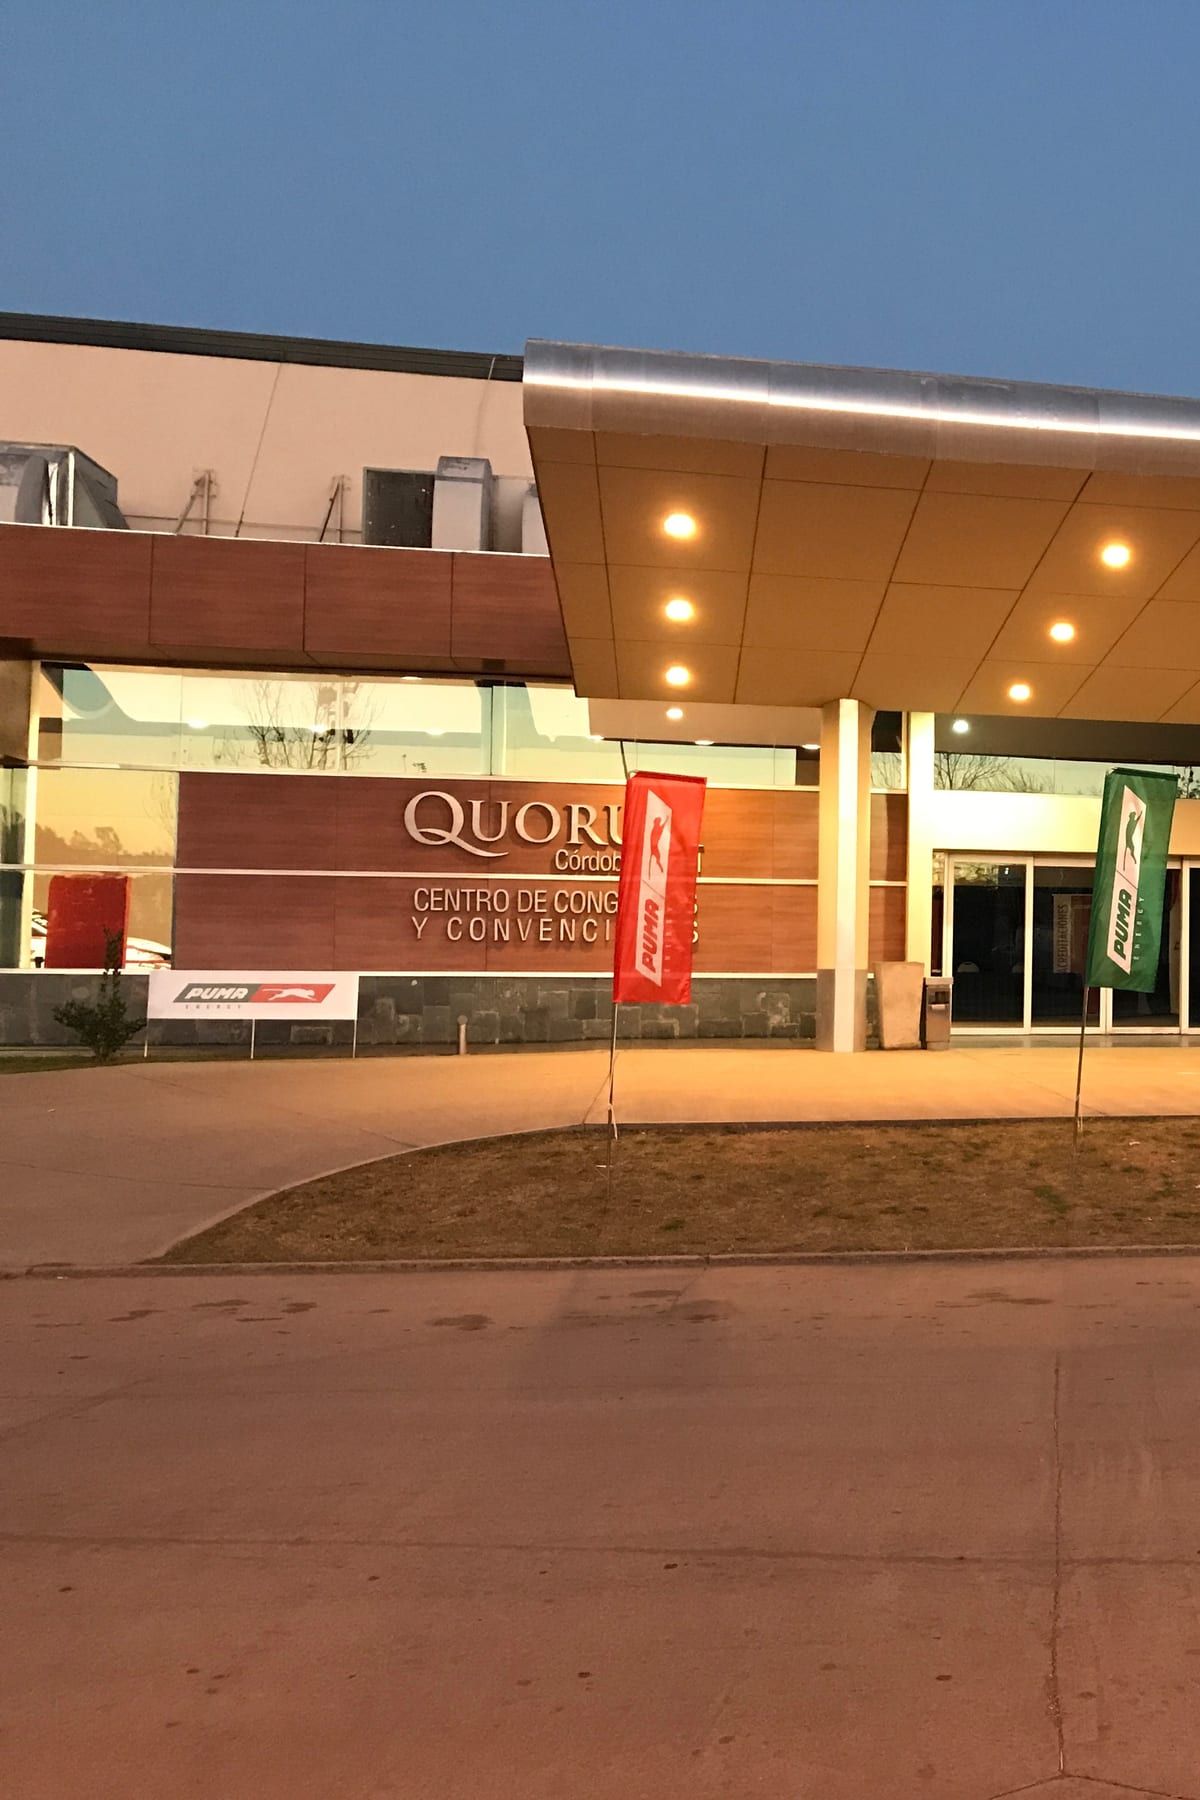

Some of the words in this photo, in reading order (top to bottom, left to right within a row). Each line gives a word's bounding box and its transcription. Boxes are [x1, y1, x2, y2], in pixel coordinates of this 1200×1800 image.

[555, 848, 622, 872] Córdob
[413, 887, 509, 913] CENTRO
[517, 889, 547, 913] DE
[411, 916, 428, 940] Y
[641, 898, 660, 973] PUMA
[1113, 888, 1133, 960] PUMA
[184, 987, 249, 1000] PUMA
